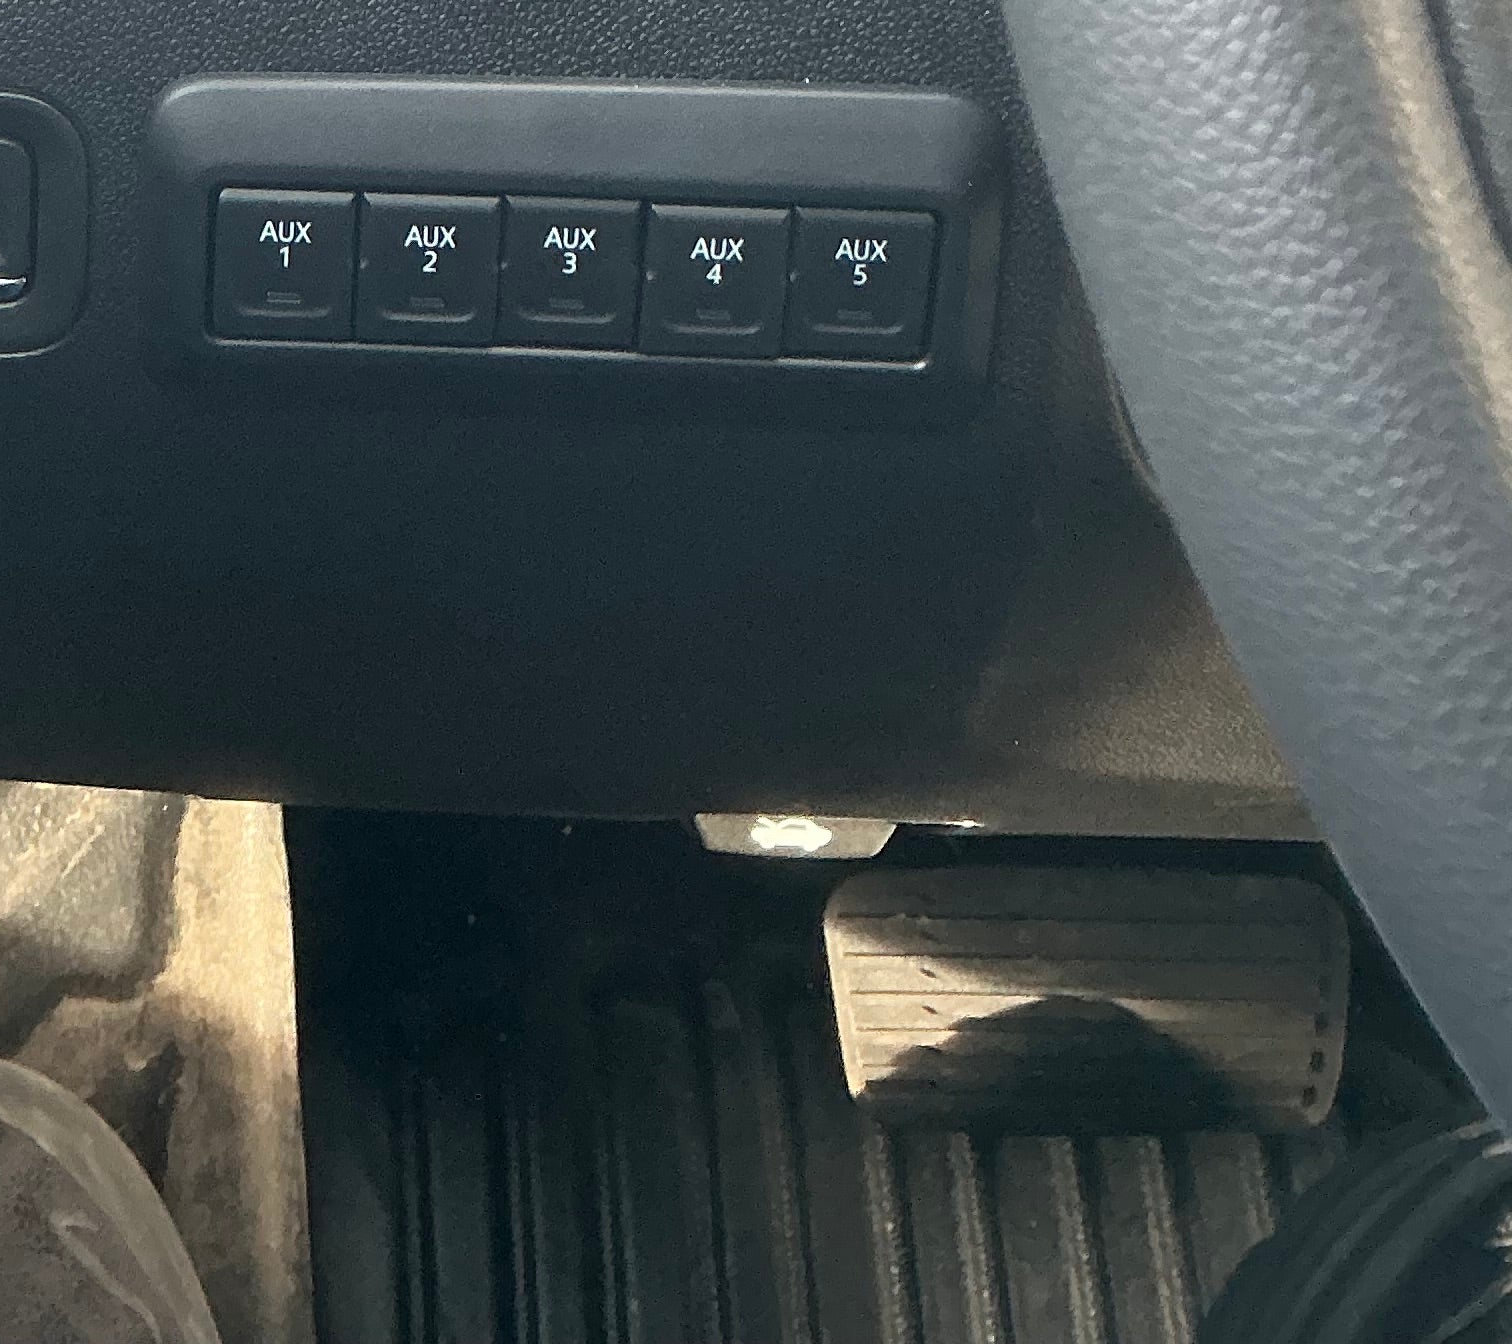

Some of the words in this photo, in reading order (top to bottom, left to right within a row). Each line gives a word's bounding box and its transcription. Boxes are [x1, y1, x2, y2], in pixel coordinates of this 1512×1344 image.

[259, 220, 312, 244] AUX
[403, 224, 456, 249] AUX
[543, 226, 597, 251] AUX
[279, 246, 290, 268] 1
[690, 236, 745, 262] AUX
[834, 238, 888, 263] AUX
[422, 250, 438, 273] 2
[561, 252, 577, 275] 3
[705, 263, 722, 285] 4
[853, 263, 868, 286] 5
